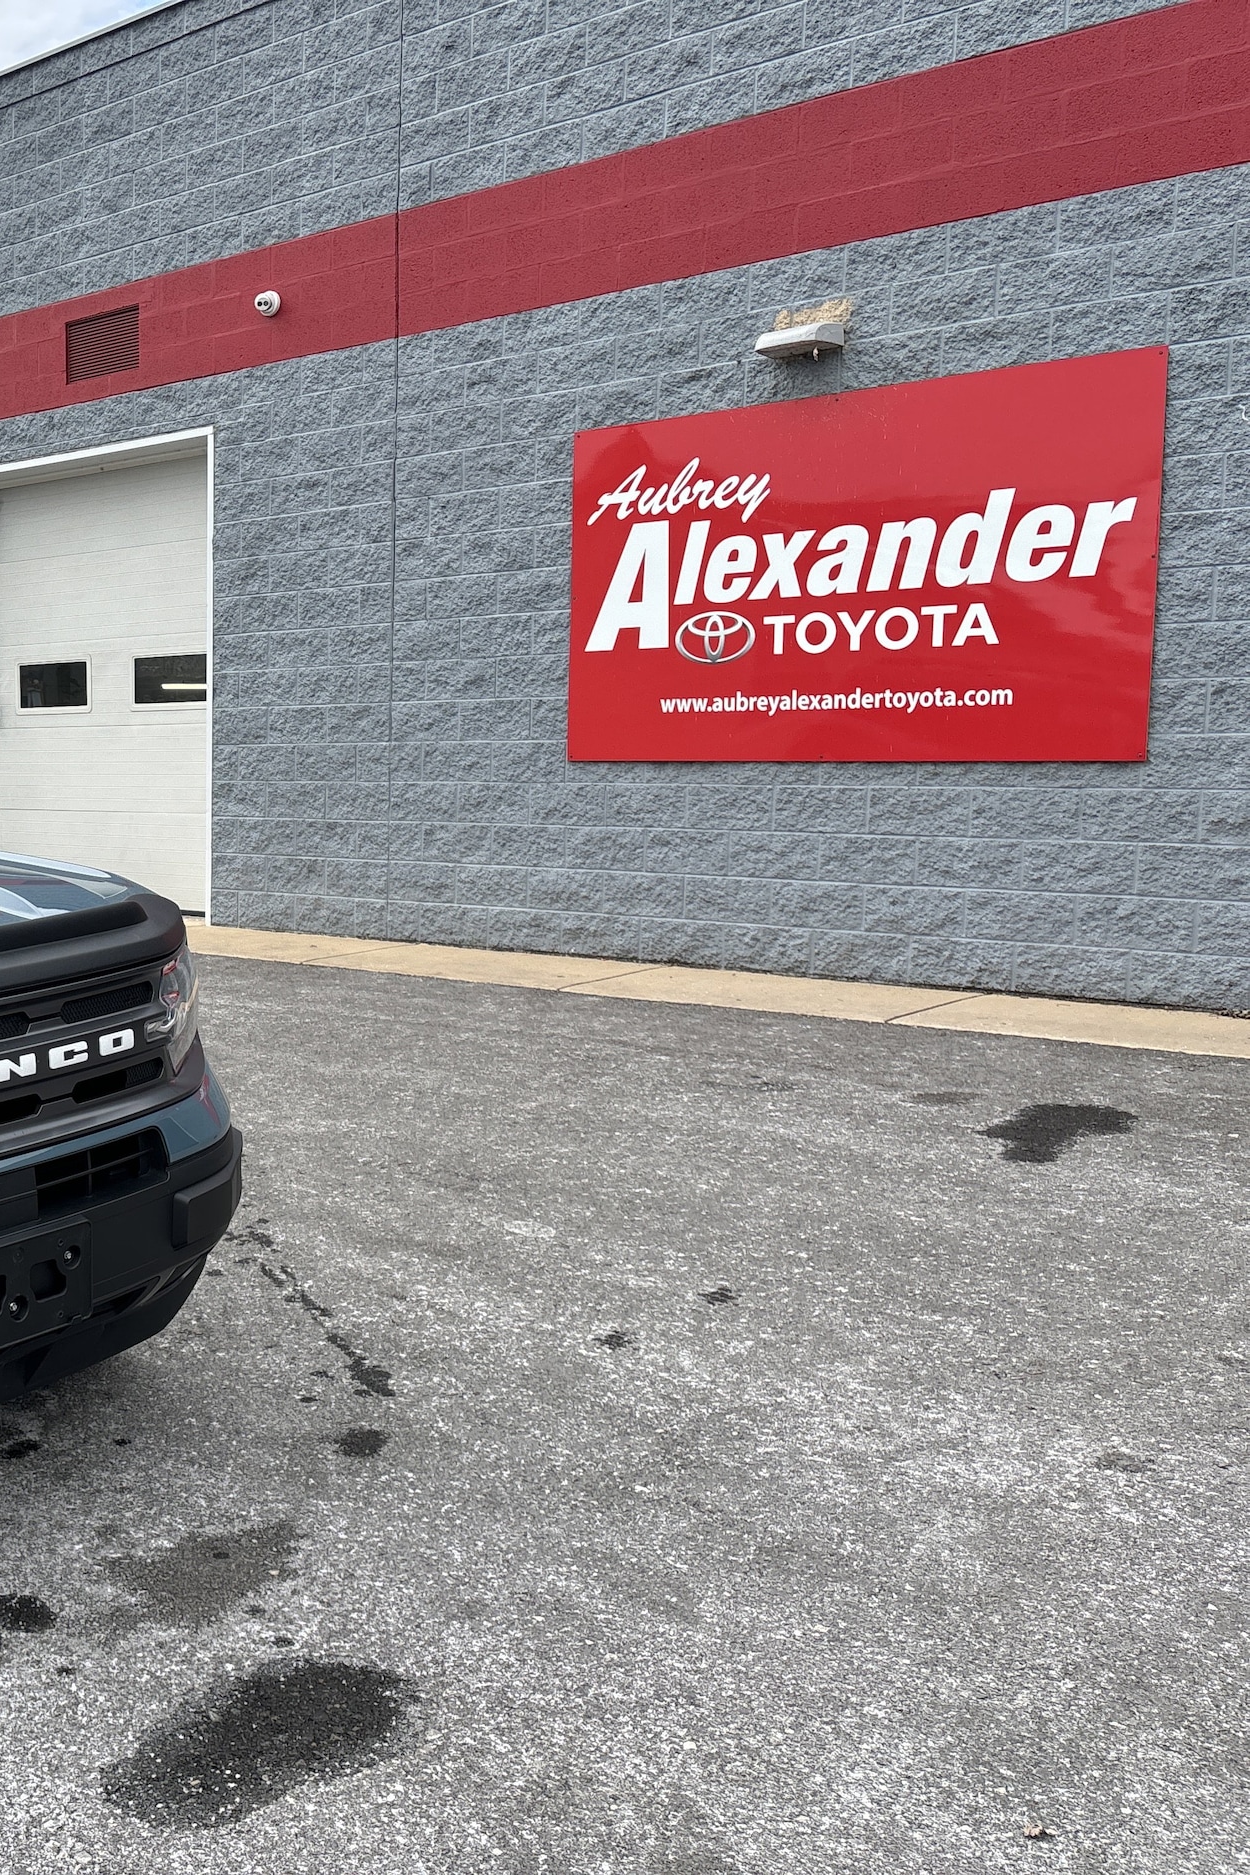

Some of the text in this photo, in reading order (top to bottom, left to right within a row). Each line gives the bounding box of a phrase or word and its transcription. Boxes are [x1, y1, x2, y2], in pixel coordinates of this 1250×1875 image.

[587, 457, 771, 526] Aubrey
[584, 487, 1138, 652] Alexander
[763, 602, 1000, 655] TOYOTA
[660, 687, 1013, 717] www.aubreyalexandertoyota.com
